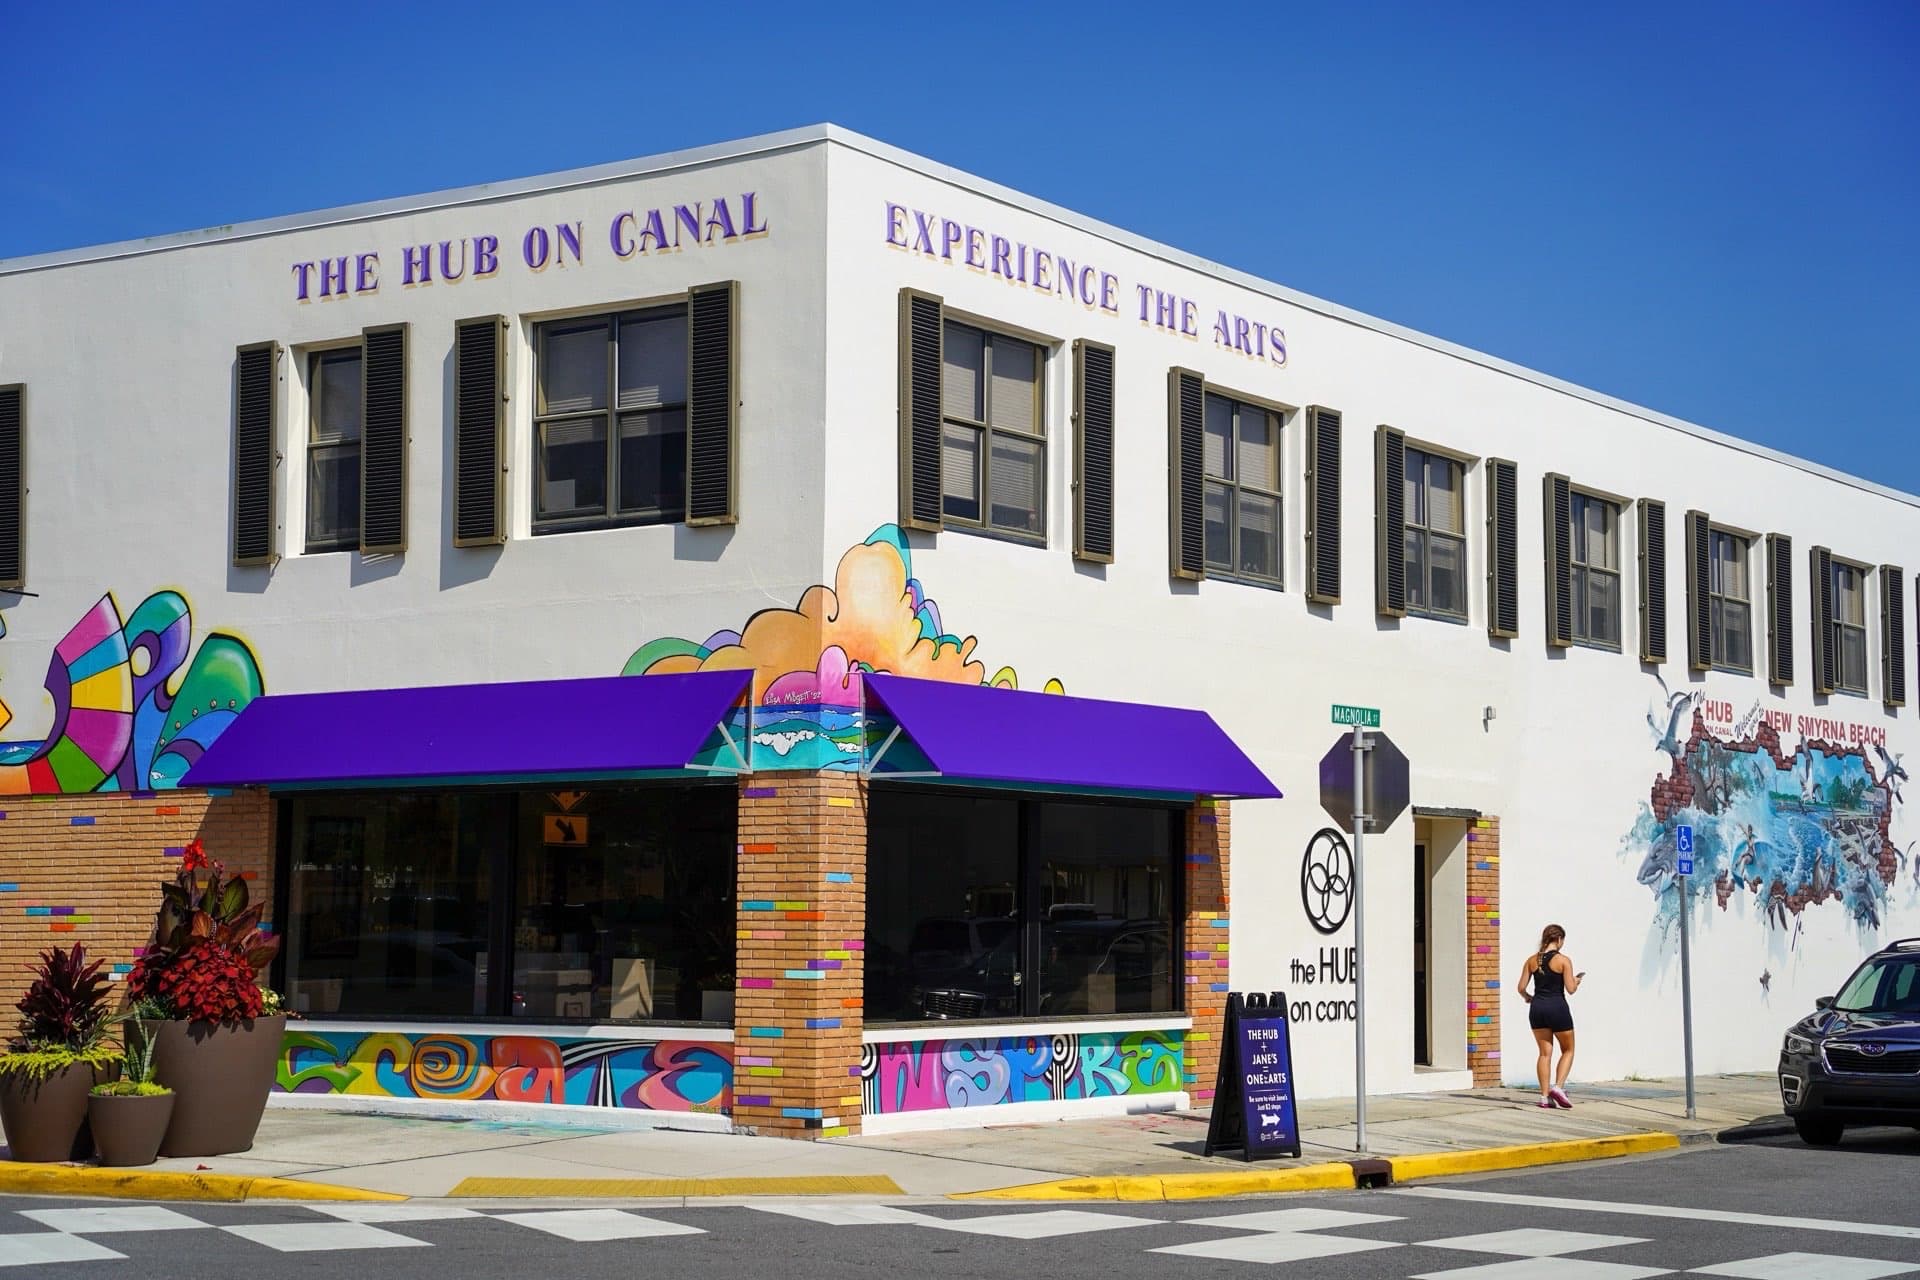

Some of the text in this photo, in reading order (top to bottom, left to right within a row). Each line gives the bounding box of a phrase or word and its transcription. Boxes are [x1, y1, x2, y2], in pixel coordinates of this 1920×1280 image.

[292, 191, 769, 303] THE HUB ON CANAL
[884, 200, 1289, 370] EXPERIENCE THE ARTS
[1334, 706, 1372, 725] MAGNOLIA
[1706, 699, 1733, 723] HUB
[1714, 725, 1733, 737] CANAL
[1765, 709, 1886, 747] NEW SMYRNA BEACH
[1290, 958, 1316, 985] the
[1290, 1001, 1312, 1023] on
[1247, 1028, 1279, 1041] THE HUB
[1252, 1053, 1278, 1065] JANE'S
[1246, 1073, 1264, 1086] ONE
[1268, 1072, 1287, 1084] ARTS
